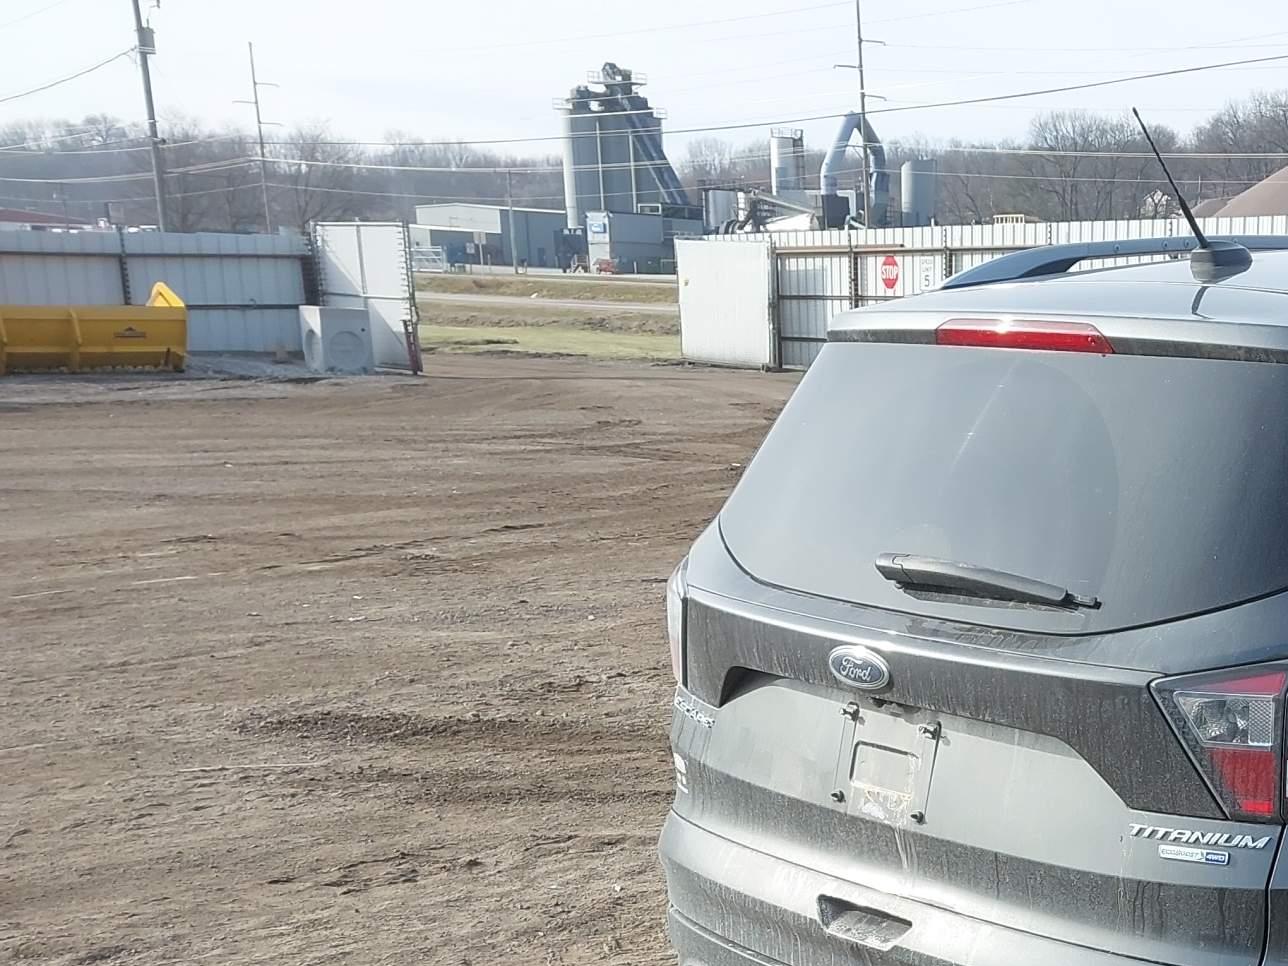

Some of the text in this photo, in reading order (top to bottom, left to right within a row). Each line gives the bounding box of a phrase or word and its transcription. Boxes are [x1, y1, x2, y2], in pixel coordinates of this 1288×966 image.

[881, 265, 898, 279] STOP
[924, 274, 930, 287] 5
[840, 656, 873, 682] Ford
[1128, 823, 1272, 849] TITANIUM
[1206, 853, 1226, 862] 4WD
